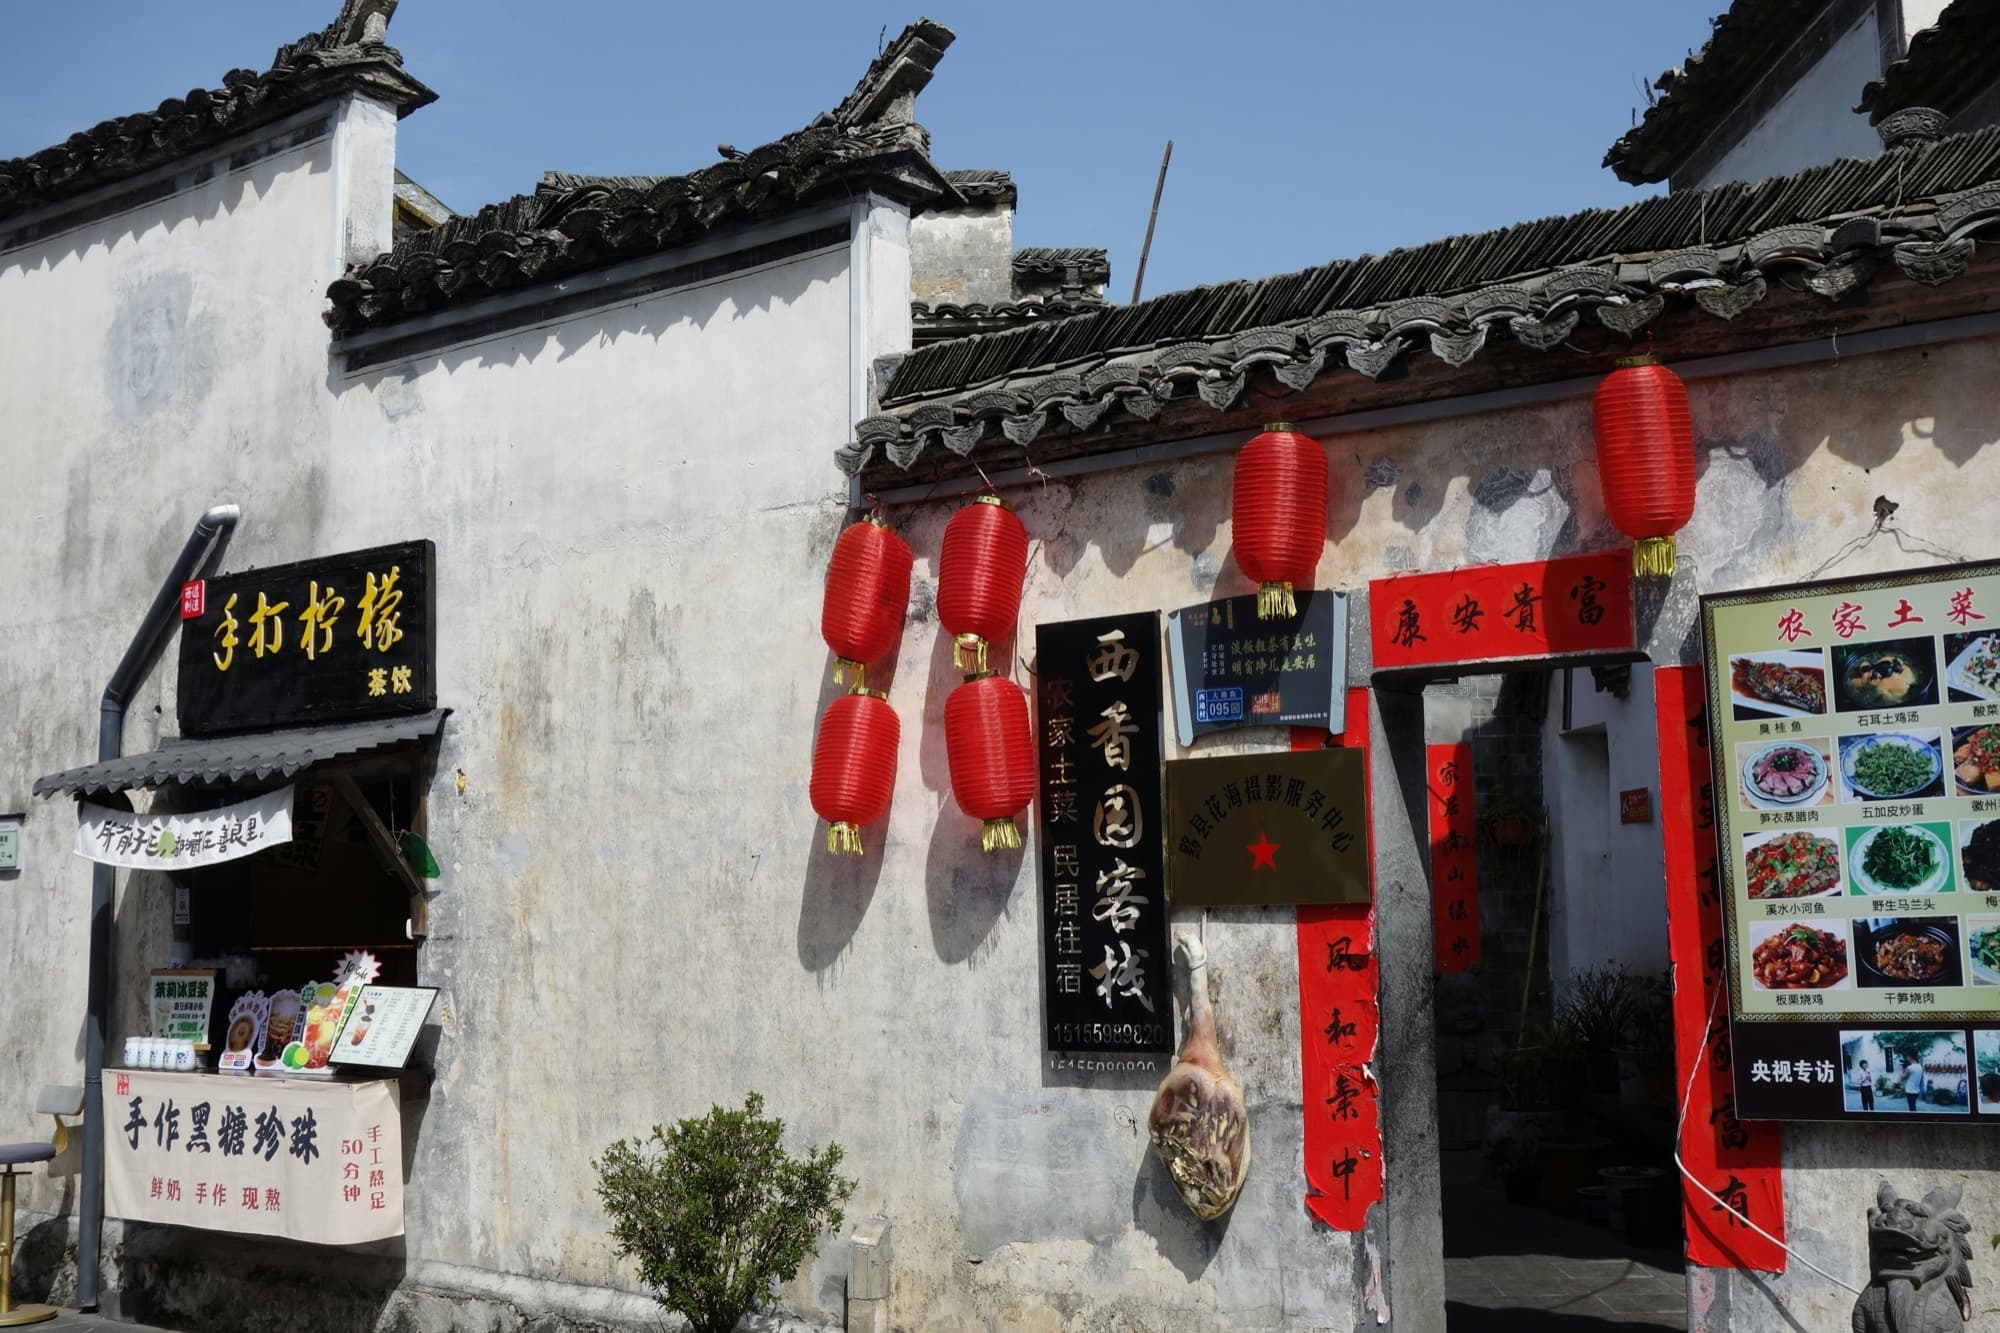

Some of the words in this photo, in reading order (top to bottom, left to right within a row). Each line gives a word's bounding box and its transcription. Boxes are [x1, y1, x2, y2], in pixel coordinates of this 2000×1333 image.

[212, 565, 403, 671] 手打柠檬
[1777, 587, 1985, 643] 农家土菜
[367, 665, 412, 696] 茶饮
[1209, 702, 1230, 716] 095
[1973, 704, 1999, 718] 酸菜
[1759, 720, 1802, 735] 臭桂鱼
[1857, 711, 1919, 727] 石耳土鸡汤
[1048, 679, 1078, 823] 农家土菜
[1861, 804, 1924, 818] 五加皮炒蛋
[1971, 799, 2000, 813] 徽州
[1178, 774, 1354, 860] 黟县花海摄影服务中心
[1759, 811, 1819, 824] 笋衣蒸腊肉
[1765, 902, 1824, 916] 溪水小河鱼
[1872, 898, 1935, 912] 野生马兰头
[1985, 896, 2000, 909] 梅
[1054, 844, 1082, 994] 民居住宿
[1775, 993, 1824, 1006] 板栗烧鸡
[1884, 992, 1934, 1005] 干笋烧肉
[1054, 1024, 1162, 1044] 15155989820
[1751, 1059, 1835, 1083] 央视专访
[124, 1096, 320, 1165] 手作黑糖珍珠
[341, 1139, 363, 1202] 50分钟
[368, 1125, 385, 1210] 手工熬足
[150, 1177, 181, 1202] 鲜奶
[195, 1183, 227, 1207] 手作
[242, 1187, 280, 1211] 现熬
